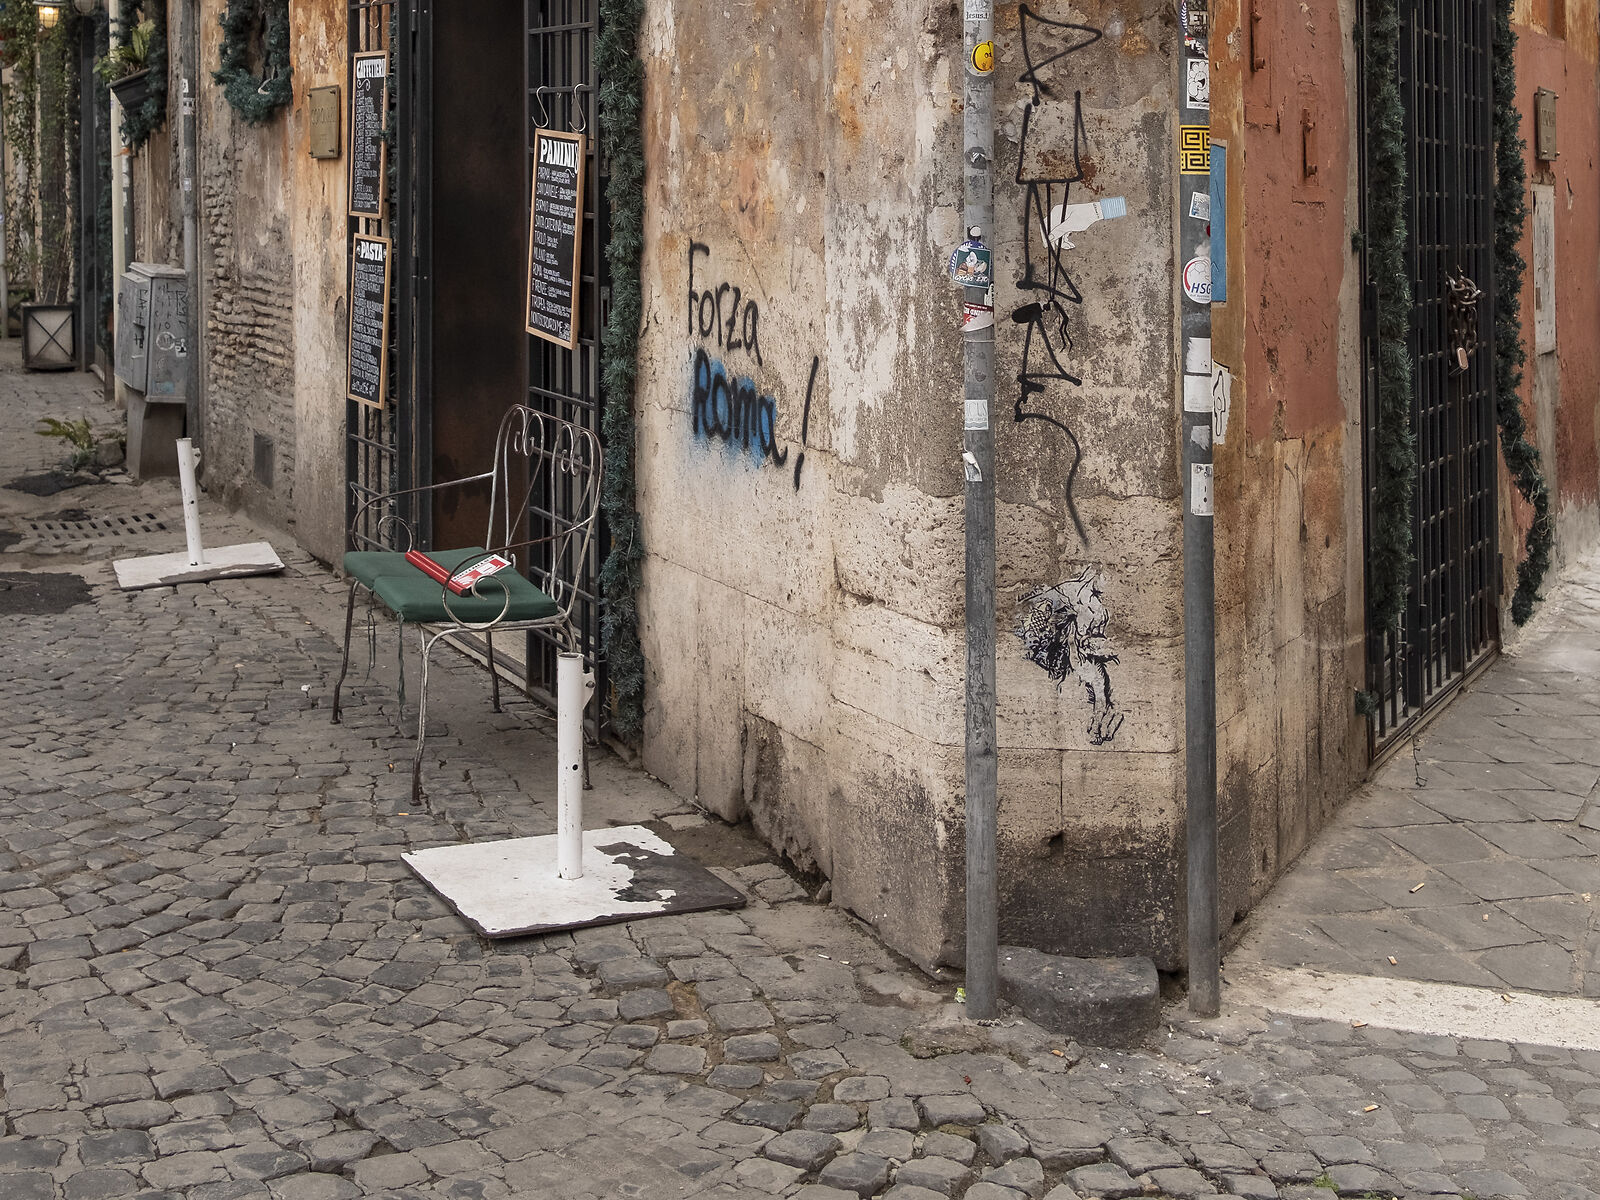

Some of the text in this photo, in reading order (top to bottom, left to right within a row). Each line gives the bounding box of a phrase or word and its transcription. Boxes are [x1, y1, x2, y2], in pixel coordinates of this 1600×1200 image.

[540, 138, 575, 167] PANINI
[361, 241, 383, 261] PASTA
[687, 238, 763, 367] Forza
